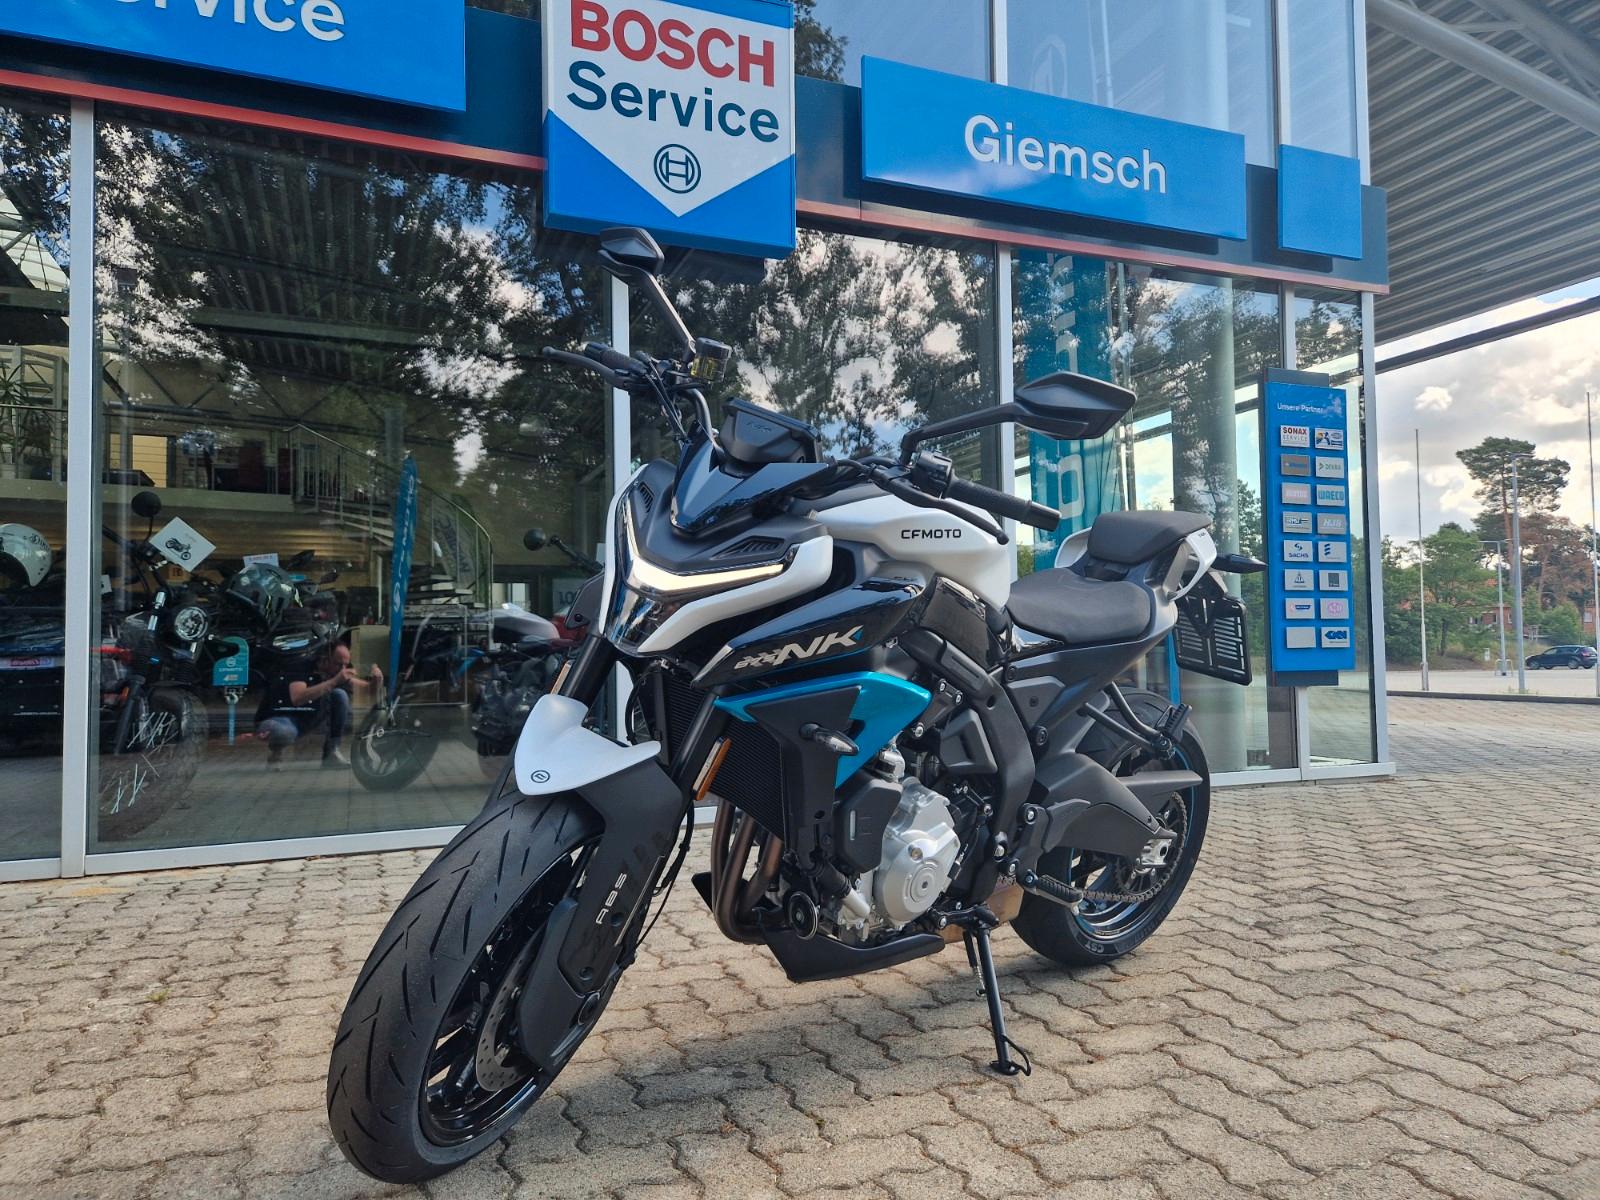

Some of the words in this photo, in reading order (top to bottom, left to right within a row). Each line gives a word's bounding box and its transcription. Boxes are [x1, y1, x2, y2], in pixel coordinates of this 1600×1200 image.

[570, 0, 775, 88] BOSCH
[566, 60, 780, 143] Service
[964, 114, 1167, 194] Giemsch
[1282, 426, 1307, 435] SONAX
[901, 528, 962, 539] CFMOTO
[595, 872, 627, 925] ABS
